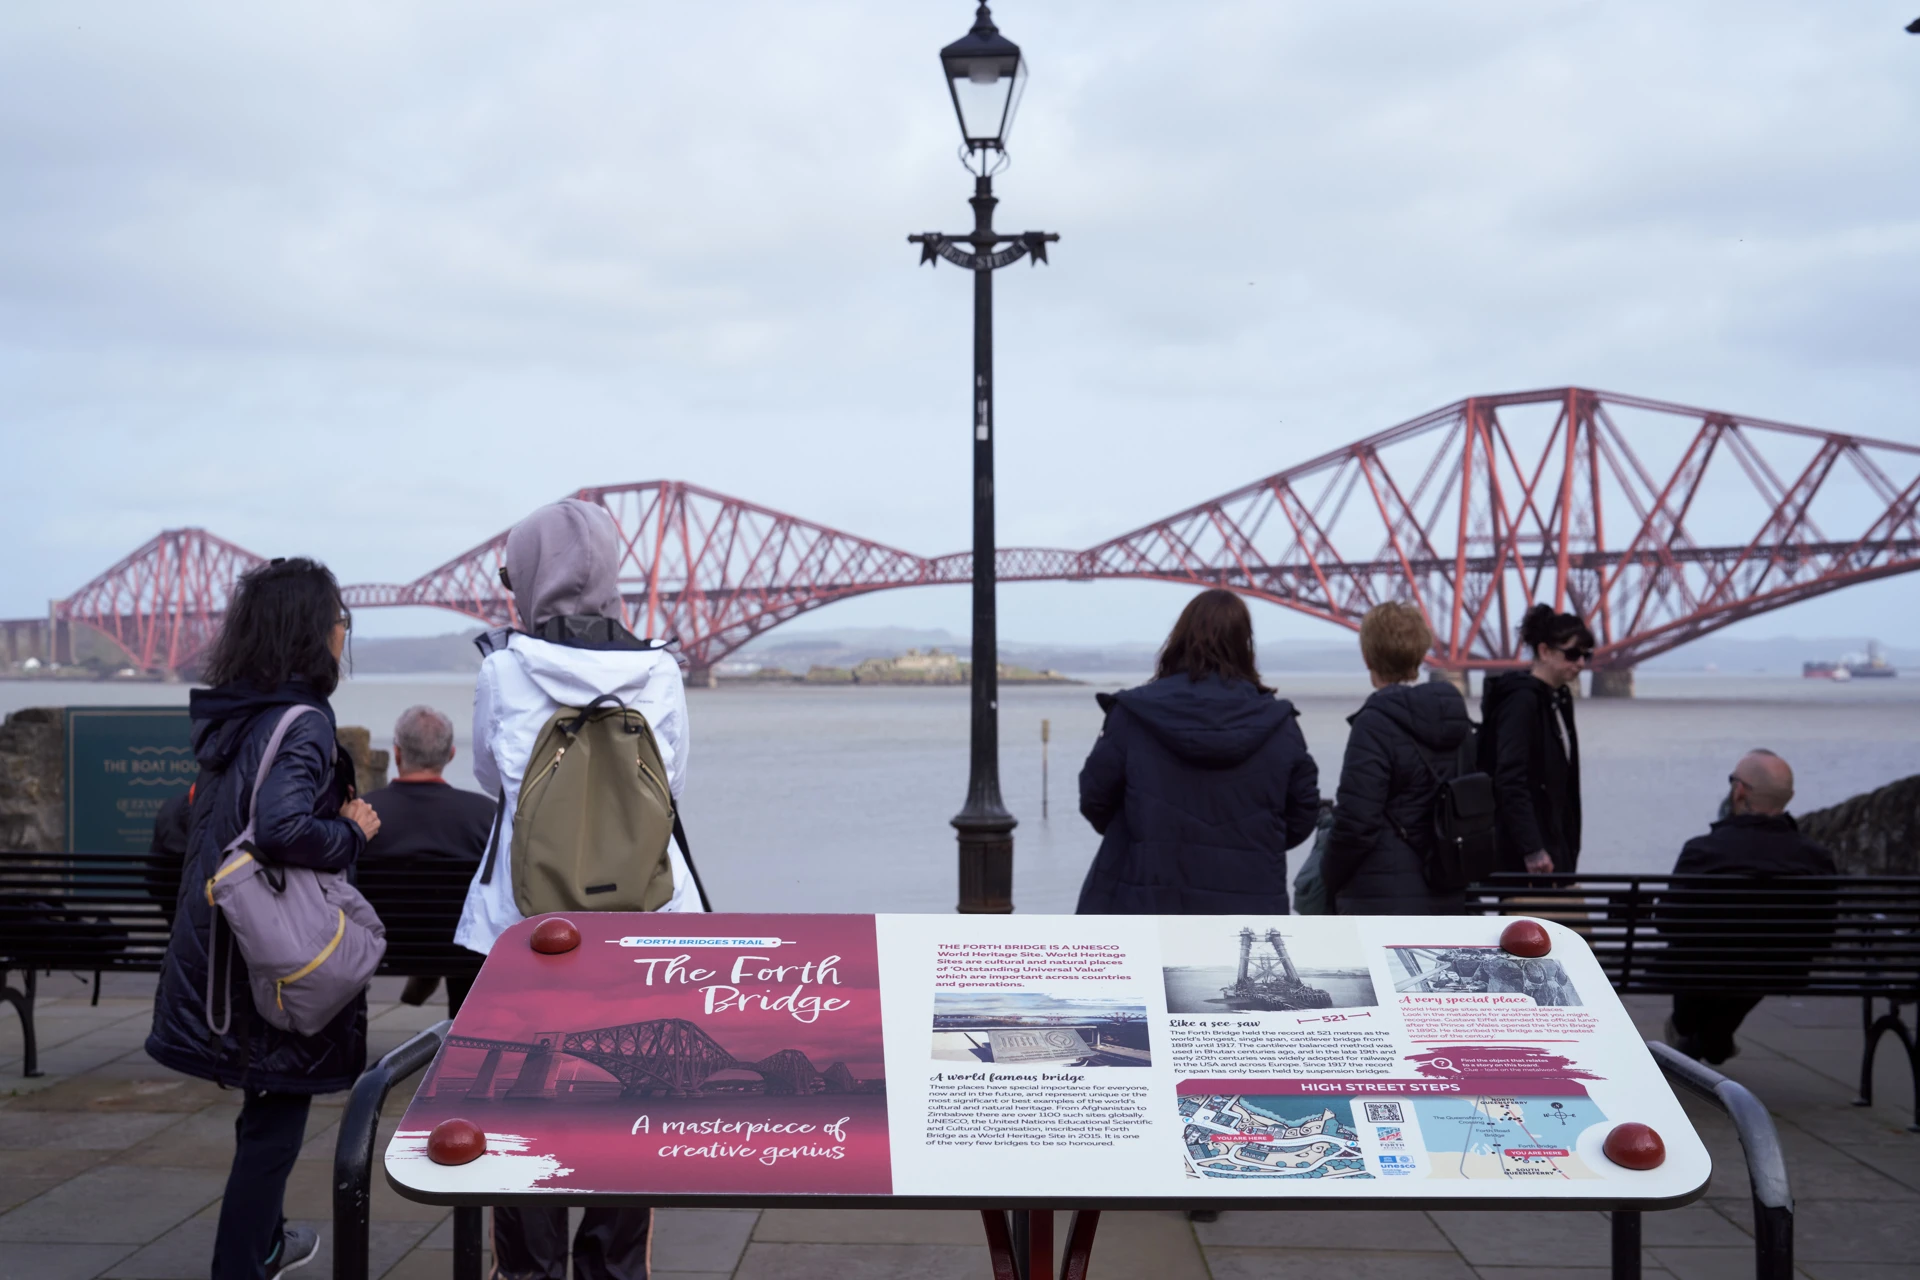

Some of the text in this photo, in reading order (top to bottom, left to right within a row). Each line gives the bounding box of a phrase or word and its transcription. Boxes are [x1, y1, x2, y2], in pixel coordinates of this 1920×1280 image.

[103, 759, 128, 773] THE
[131, 759, 166, 773] BOAT
[634, 954, 842, 986] The Forth
[699, 984, 850, 1023] Bridge
[1398, 996, 1411, 1004] A
[1445, 996, 1489, 1004] special
[1492, 996, 1528, 1004] place
[1169, 1019, 1196, 1027] Like
[1322, 1014, 1349, 1023] 521
[930, 1073, 1084, 1083] A world famous bridge
[1301, 1083, 1460, 1091] HIGH STREET STEPS
[632, 1115, 850, 1142] A masterpiece of
[658, 1141, 845, 1166] creative genius
